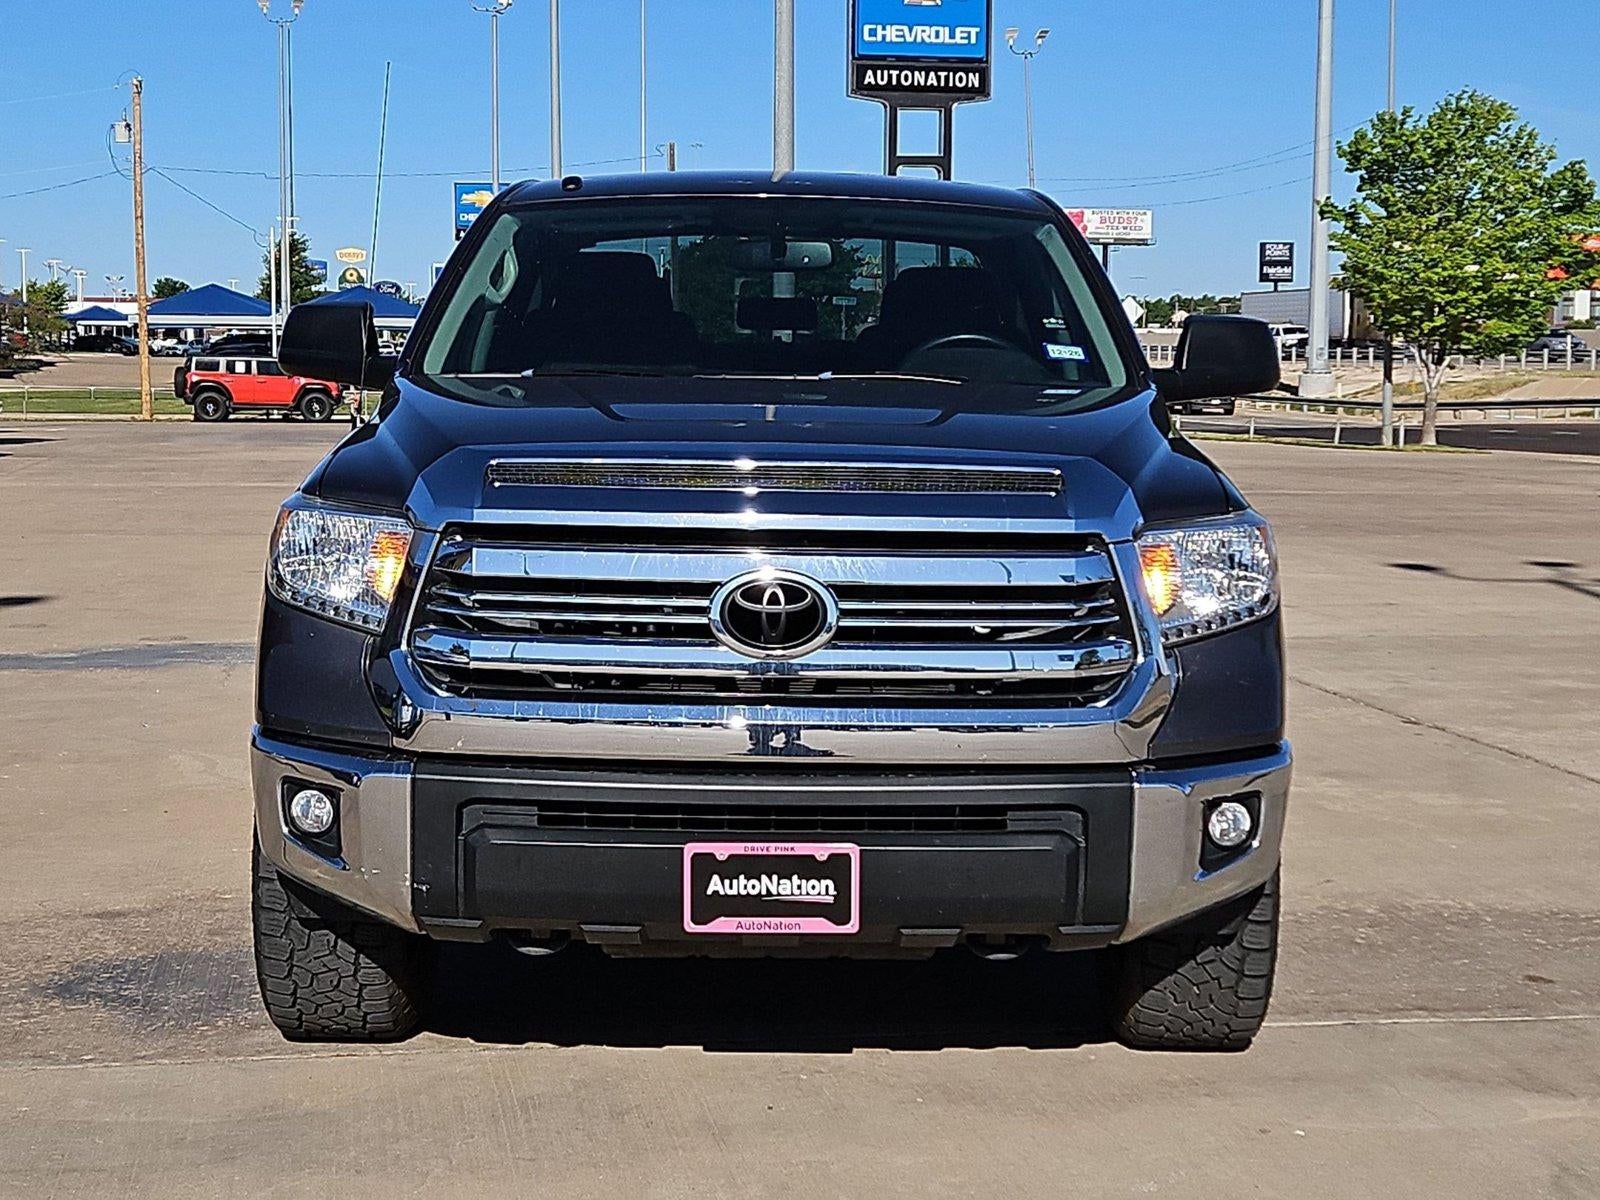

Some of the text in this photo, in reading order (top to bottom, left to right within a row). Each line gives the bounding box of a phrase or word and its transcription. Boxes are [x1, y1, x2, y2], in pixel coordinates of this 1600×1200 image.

[863, 24, 980, 44] CHEVROLET
[863, 69, 980, 88] AUTONATION
[1099, 216, 1139, 225] BUDS?
[379, 286, 397, 294] Ford
[706, 873, 838, 896] AutoNation
[735, 920, 801, 931] AutoNation
